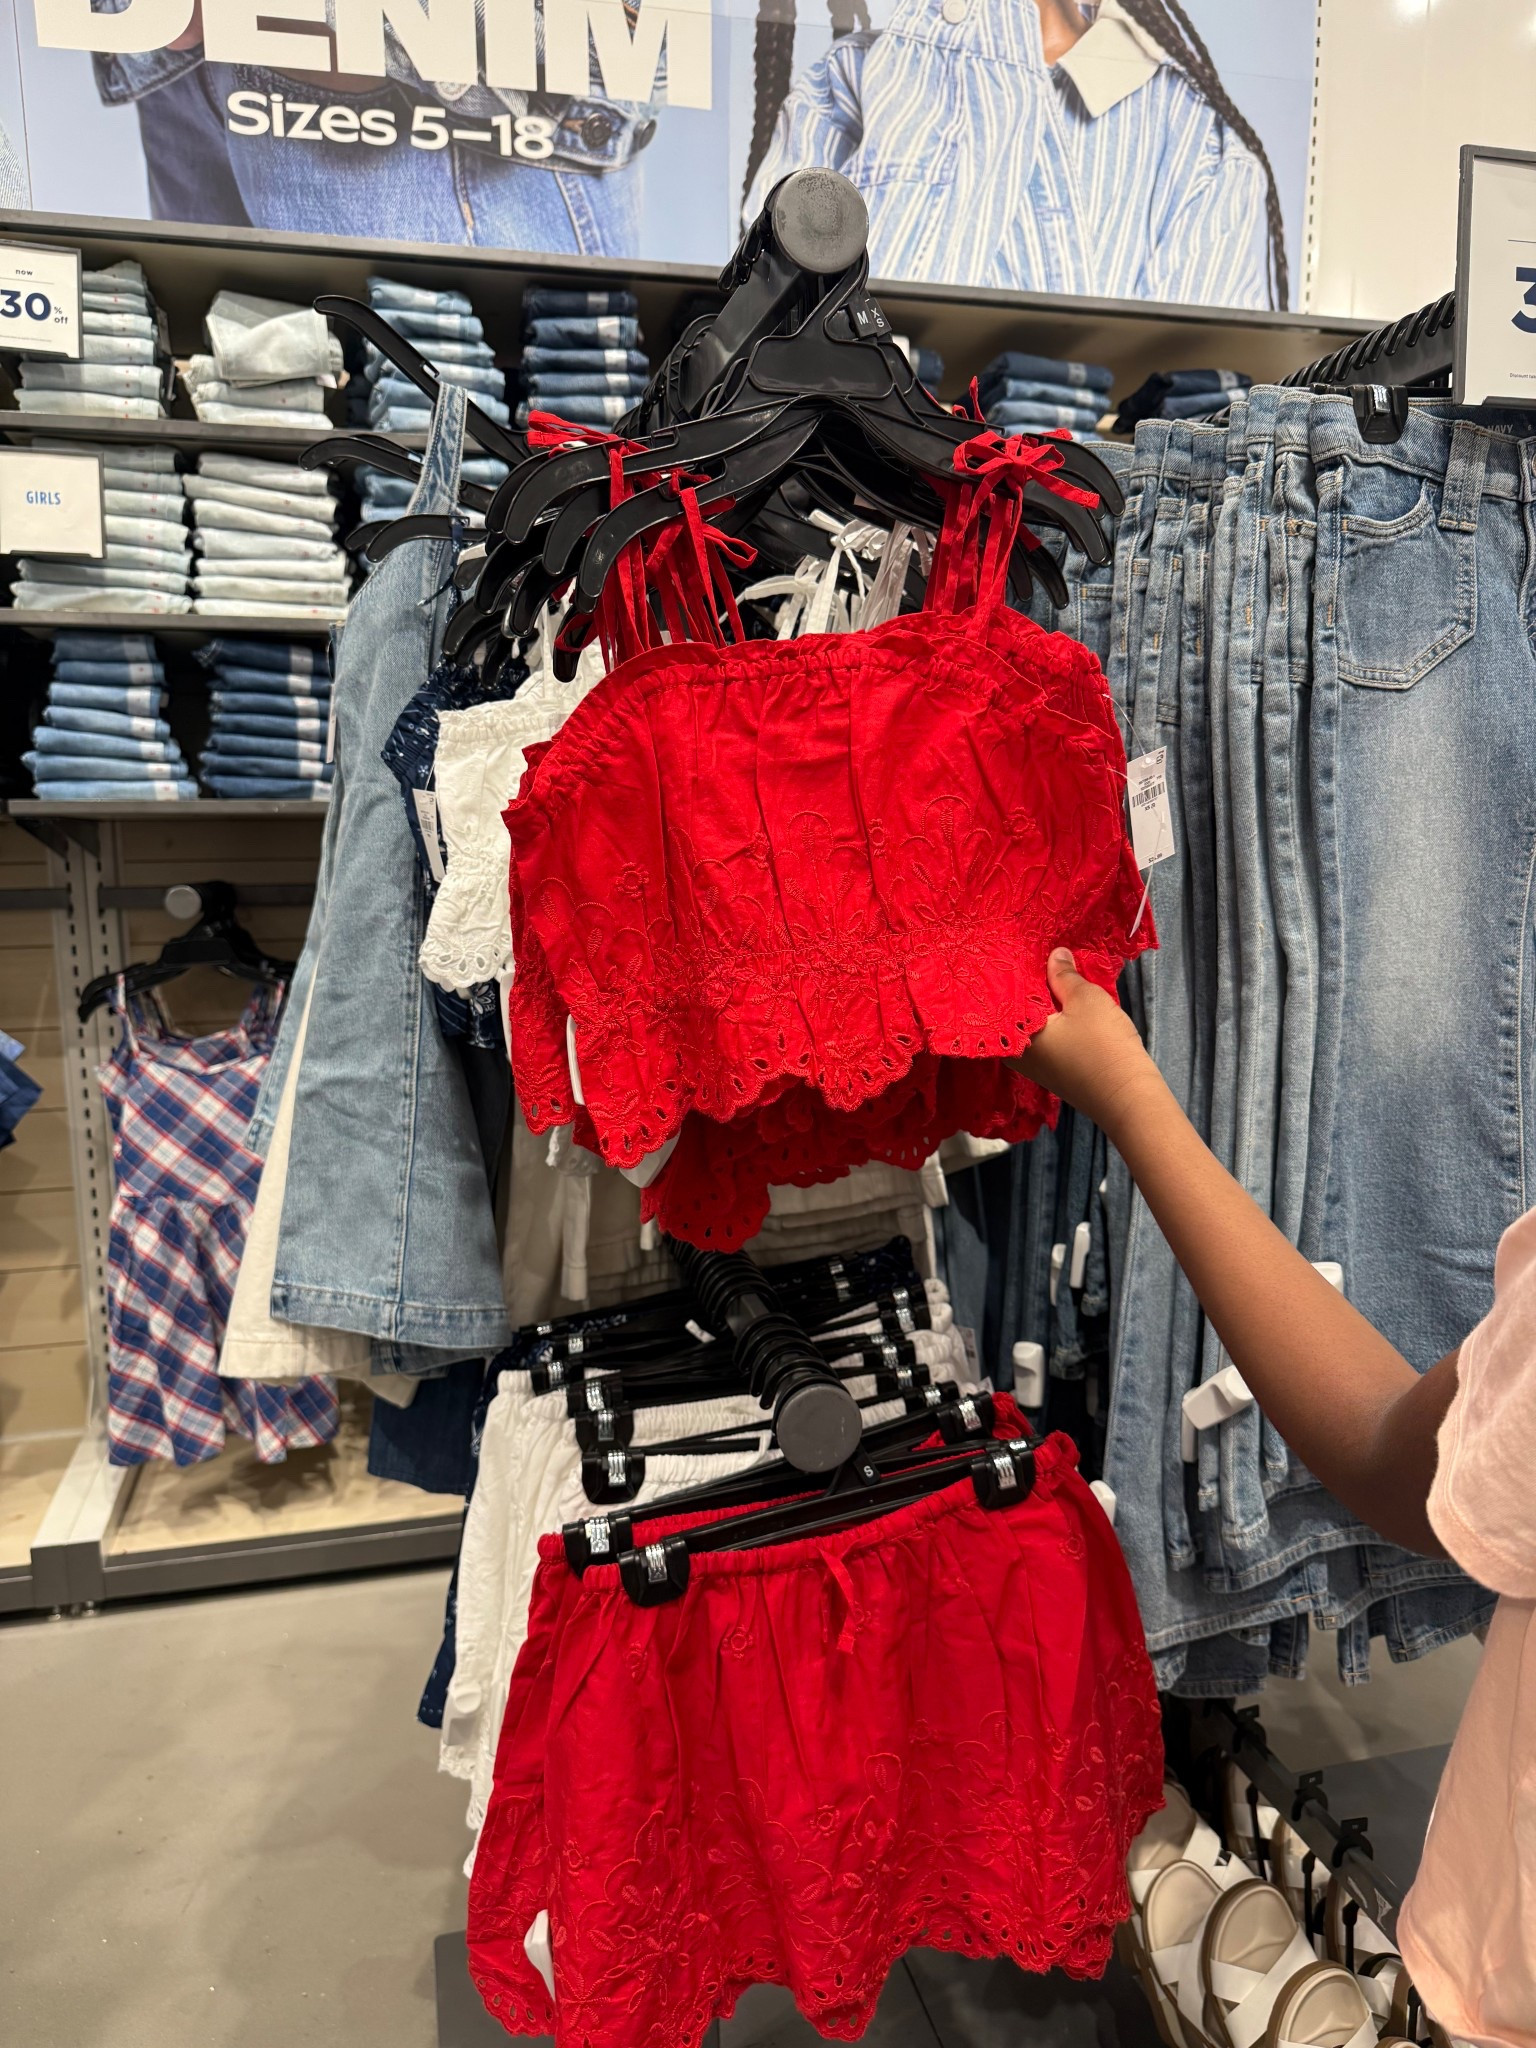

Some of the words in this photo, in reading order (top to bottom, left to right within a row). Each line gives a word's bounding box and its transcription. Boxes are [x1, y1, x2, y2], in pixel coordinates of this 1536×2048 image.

[227, 90, 398, 146] Sizes
[15, 268, 33, 276] now
[0, 289, 51, 321] 30
[54, 316, 68, 324] off
[856, 310, 869, 325] M
[26, 490, 62, 506] GIRLS
[863, 1465, 874, 1478] S
